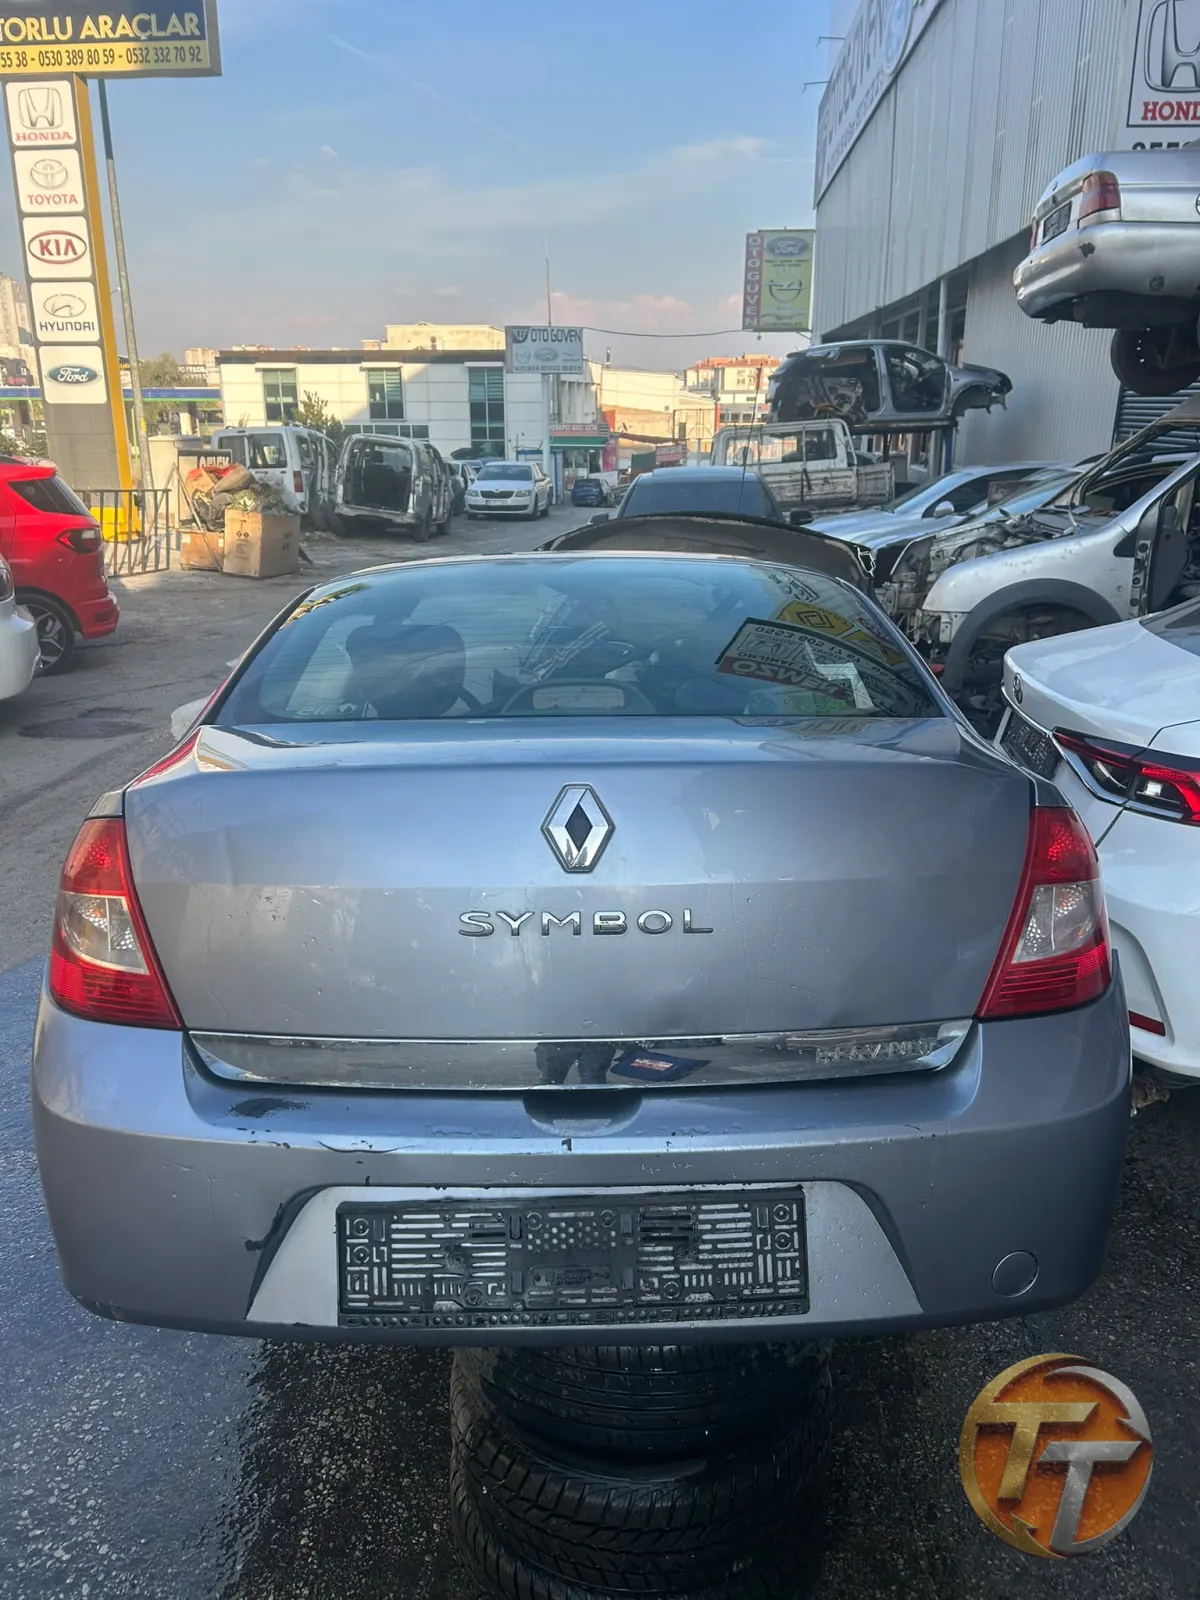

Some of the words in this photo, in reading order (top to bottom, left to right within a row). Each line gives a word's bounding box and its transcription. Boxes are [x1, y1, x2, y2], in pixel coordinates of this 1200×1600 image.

[80, 12, 200, 40] ARAÇLAR
[0, 51, 13, 68] 55
[15, 51, 28, 68] 38
[38, 50, 63, 67] 0530
[65, 49, 84, 66] 389
[87, 49, 100, 65] 80
[103, 48, 115, 65] 59
[126, 47, 150, 64] 0532
[154, 46, 171, 63] 332
[174, 46, 186, 62] 70
[190, 46, 202, 62] 92
[15, 131, 73, 141] HONDA
[27, 193, 79, 205] TOYOTA
[39, 239, 78, 256] KIA
[39, 321, 95, 331] HYUNDAI
[530, 328, 549, 342] OTO
[57, 367, 89, 382] Ford
[458, 909, 714, 937] SYMBOL
